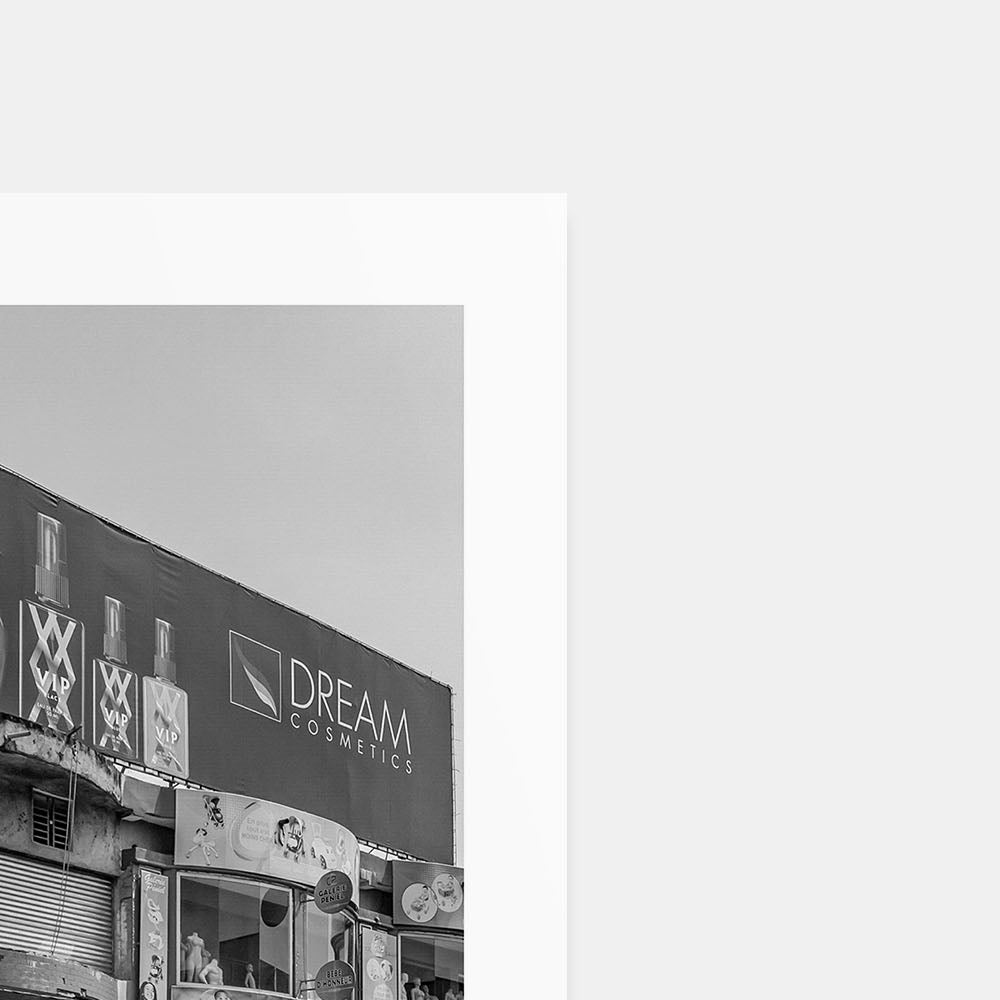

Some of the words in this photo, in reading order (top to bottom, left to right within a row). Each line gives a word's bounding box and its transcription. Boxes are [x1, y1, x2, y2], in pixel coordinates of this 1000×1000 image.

[34, 666, 71, 695] VIP
[104, 706, 129, 727] VIP
[291, 657, 412, 755] DREAM
[155, 725, 179, 745] VIP
[290, 712, 413, 775] COSMETICS
